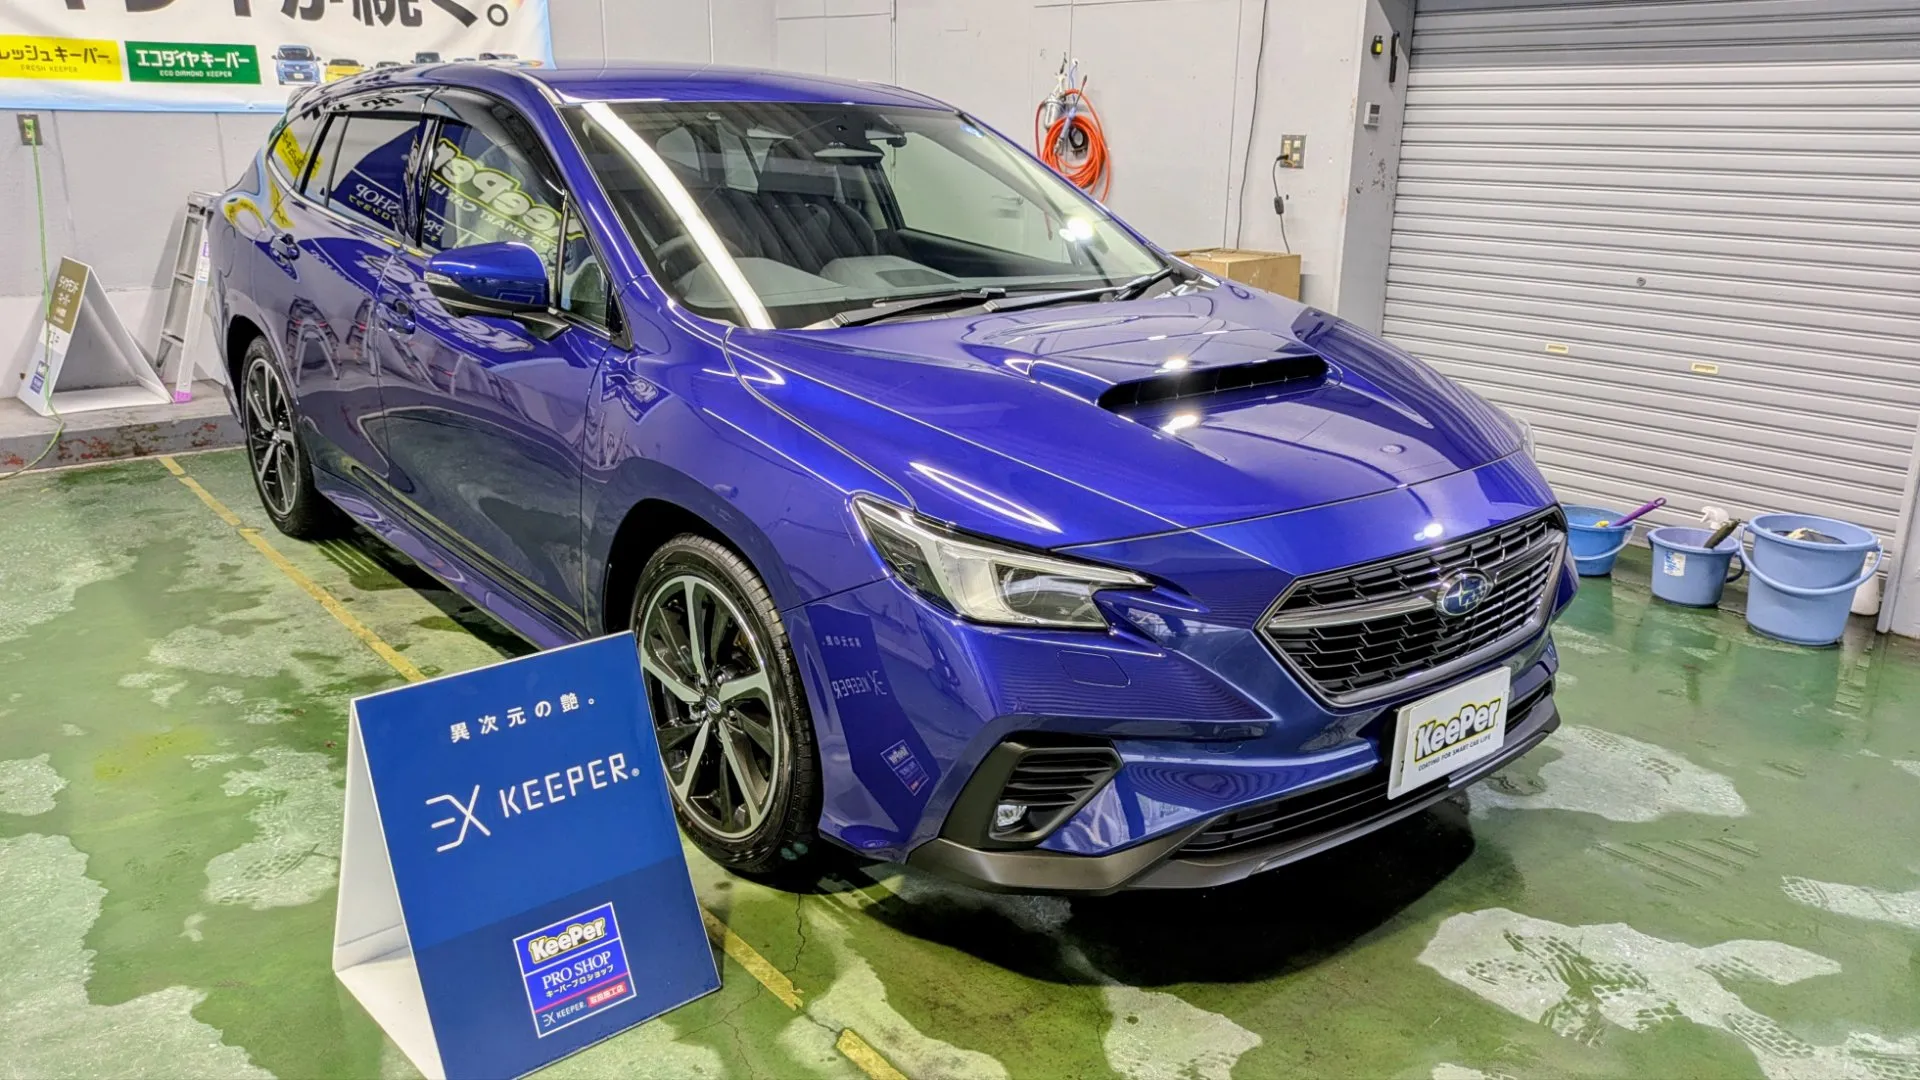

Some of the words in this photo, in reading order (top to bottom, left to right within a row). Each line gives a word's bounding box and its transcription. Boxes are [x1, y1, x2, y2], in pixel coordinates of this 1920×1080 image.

[20, 64, 47, 72] FRESH
[135, 49, 250, 69] エコダイヤキーパー
[1414, 699, 1501, 763] KeePer
[1418, 756, 1440, 771] COATING
[1441, 752, 1452, 761] FOR
[1452, 745, 1469, 756] SMART
[529, 917, 606, 964] KeePer
[541, 967, 573, 989] PRO
[574, 951, 611, 976] SHOP
[546, 964, 614, 998] キーパープロショップ
[556, 1002, 585, 1019] KEEPER
